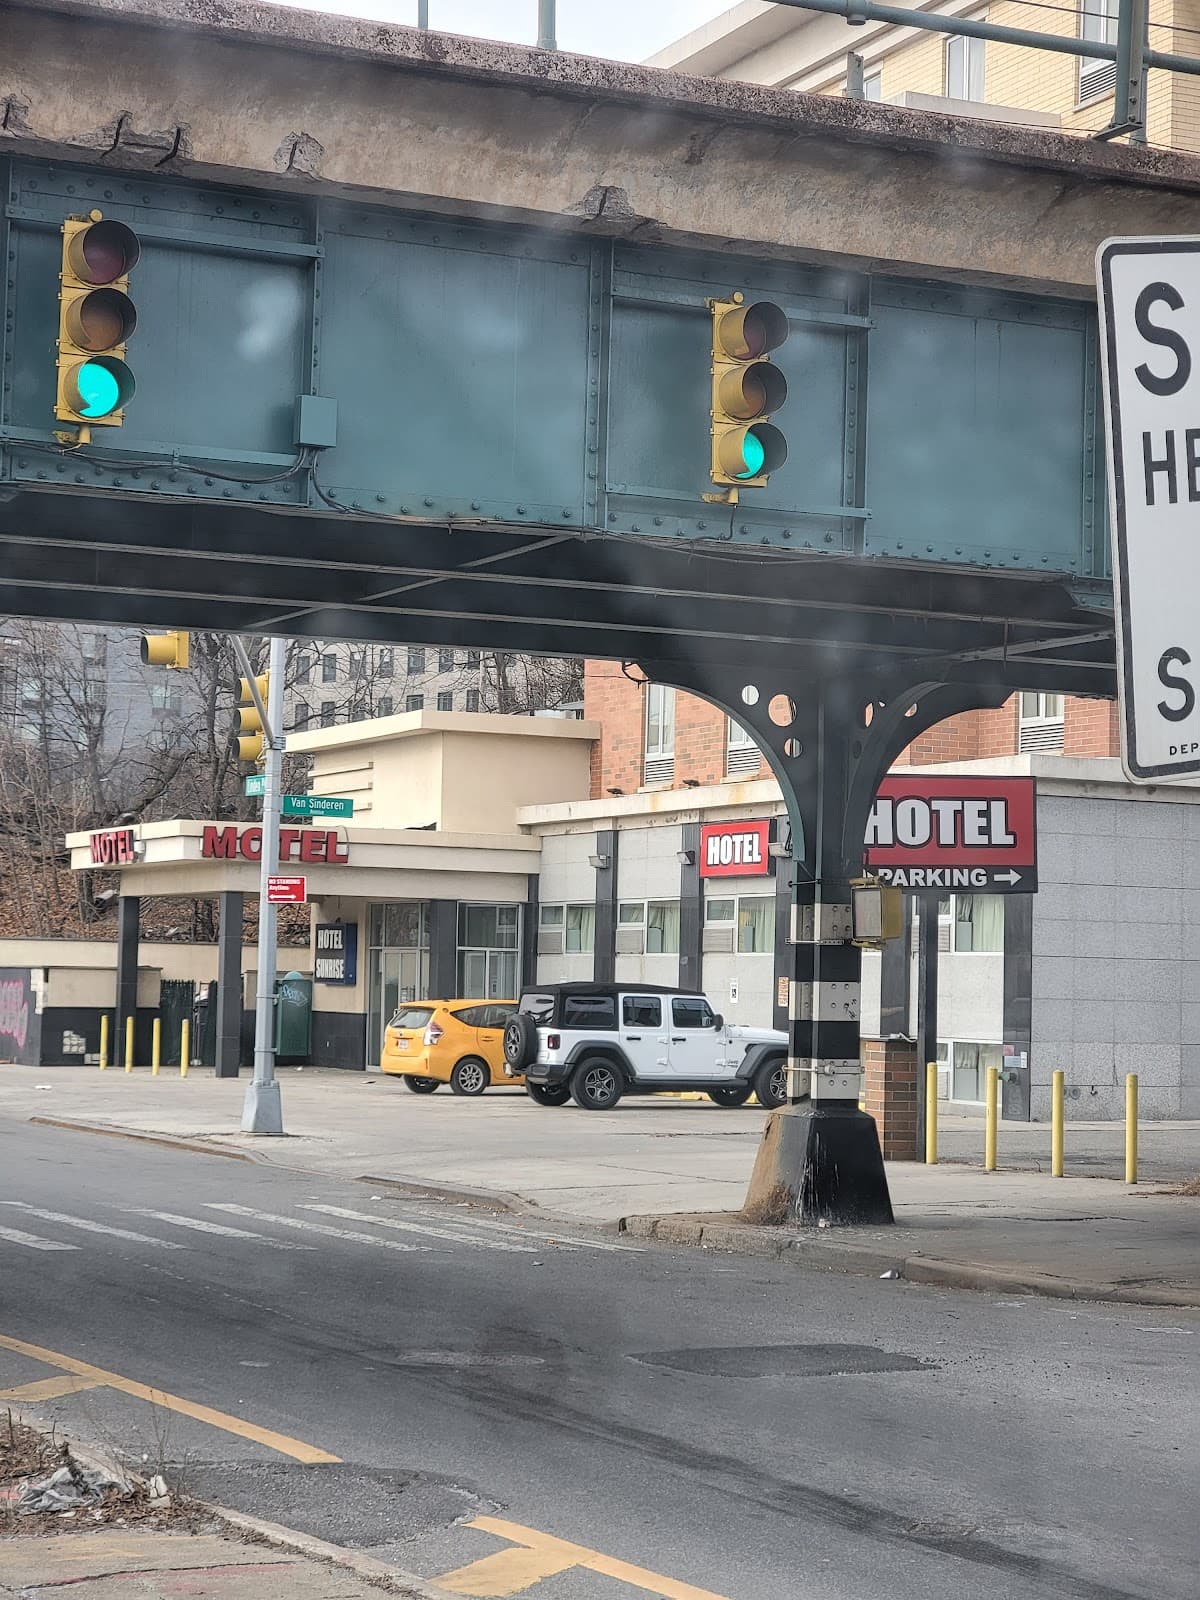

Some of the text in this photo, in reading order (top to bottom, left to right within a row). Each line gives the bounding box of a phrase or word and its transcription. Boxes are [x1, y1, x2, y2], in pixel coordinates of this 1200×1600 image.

[291, 797, 345, 811] Van Sinderen
[863, 799, 1015, 846] HOTEL
[90, 829, 135, 864] MOTEL
[203, 825, 349, 864] MOTEL
[707, 833, 762, 866] HOTEL
[878, 867, 988, 888] PARKING
[317, 929, 343, 950] HOTEL
[315, 957, 345, 979] SUNRISE
